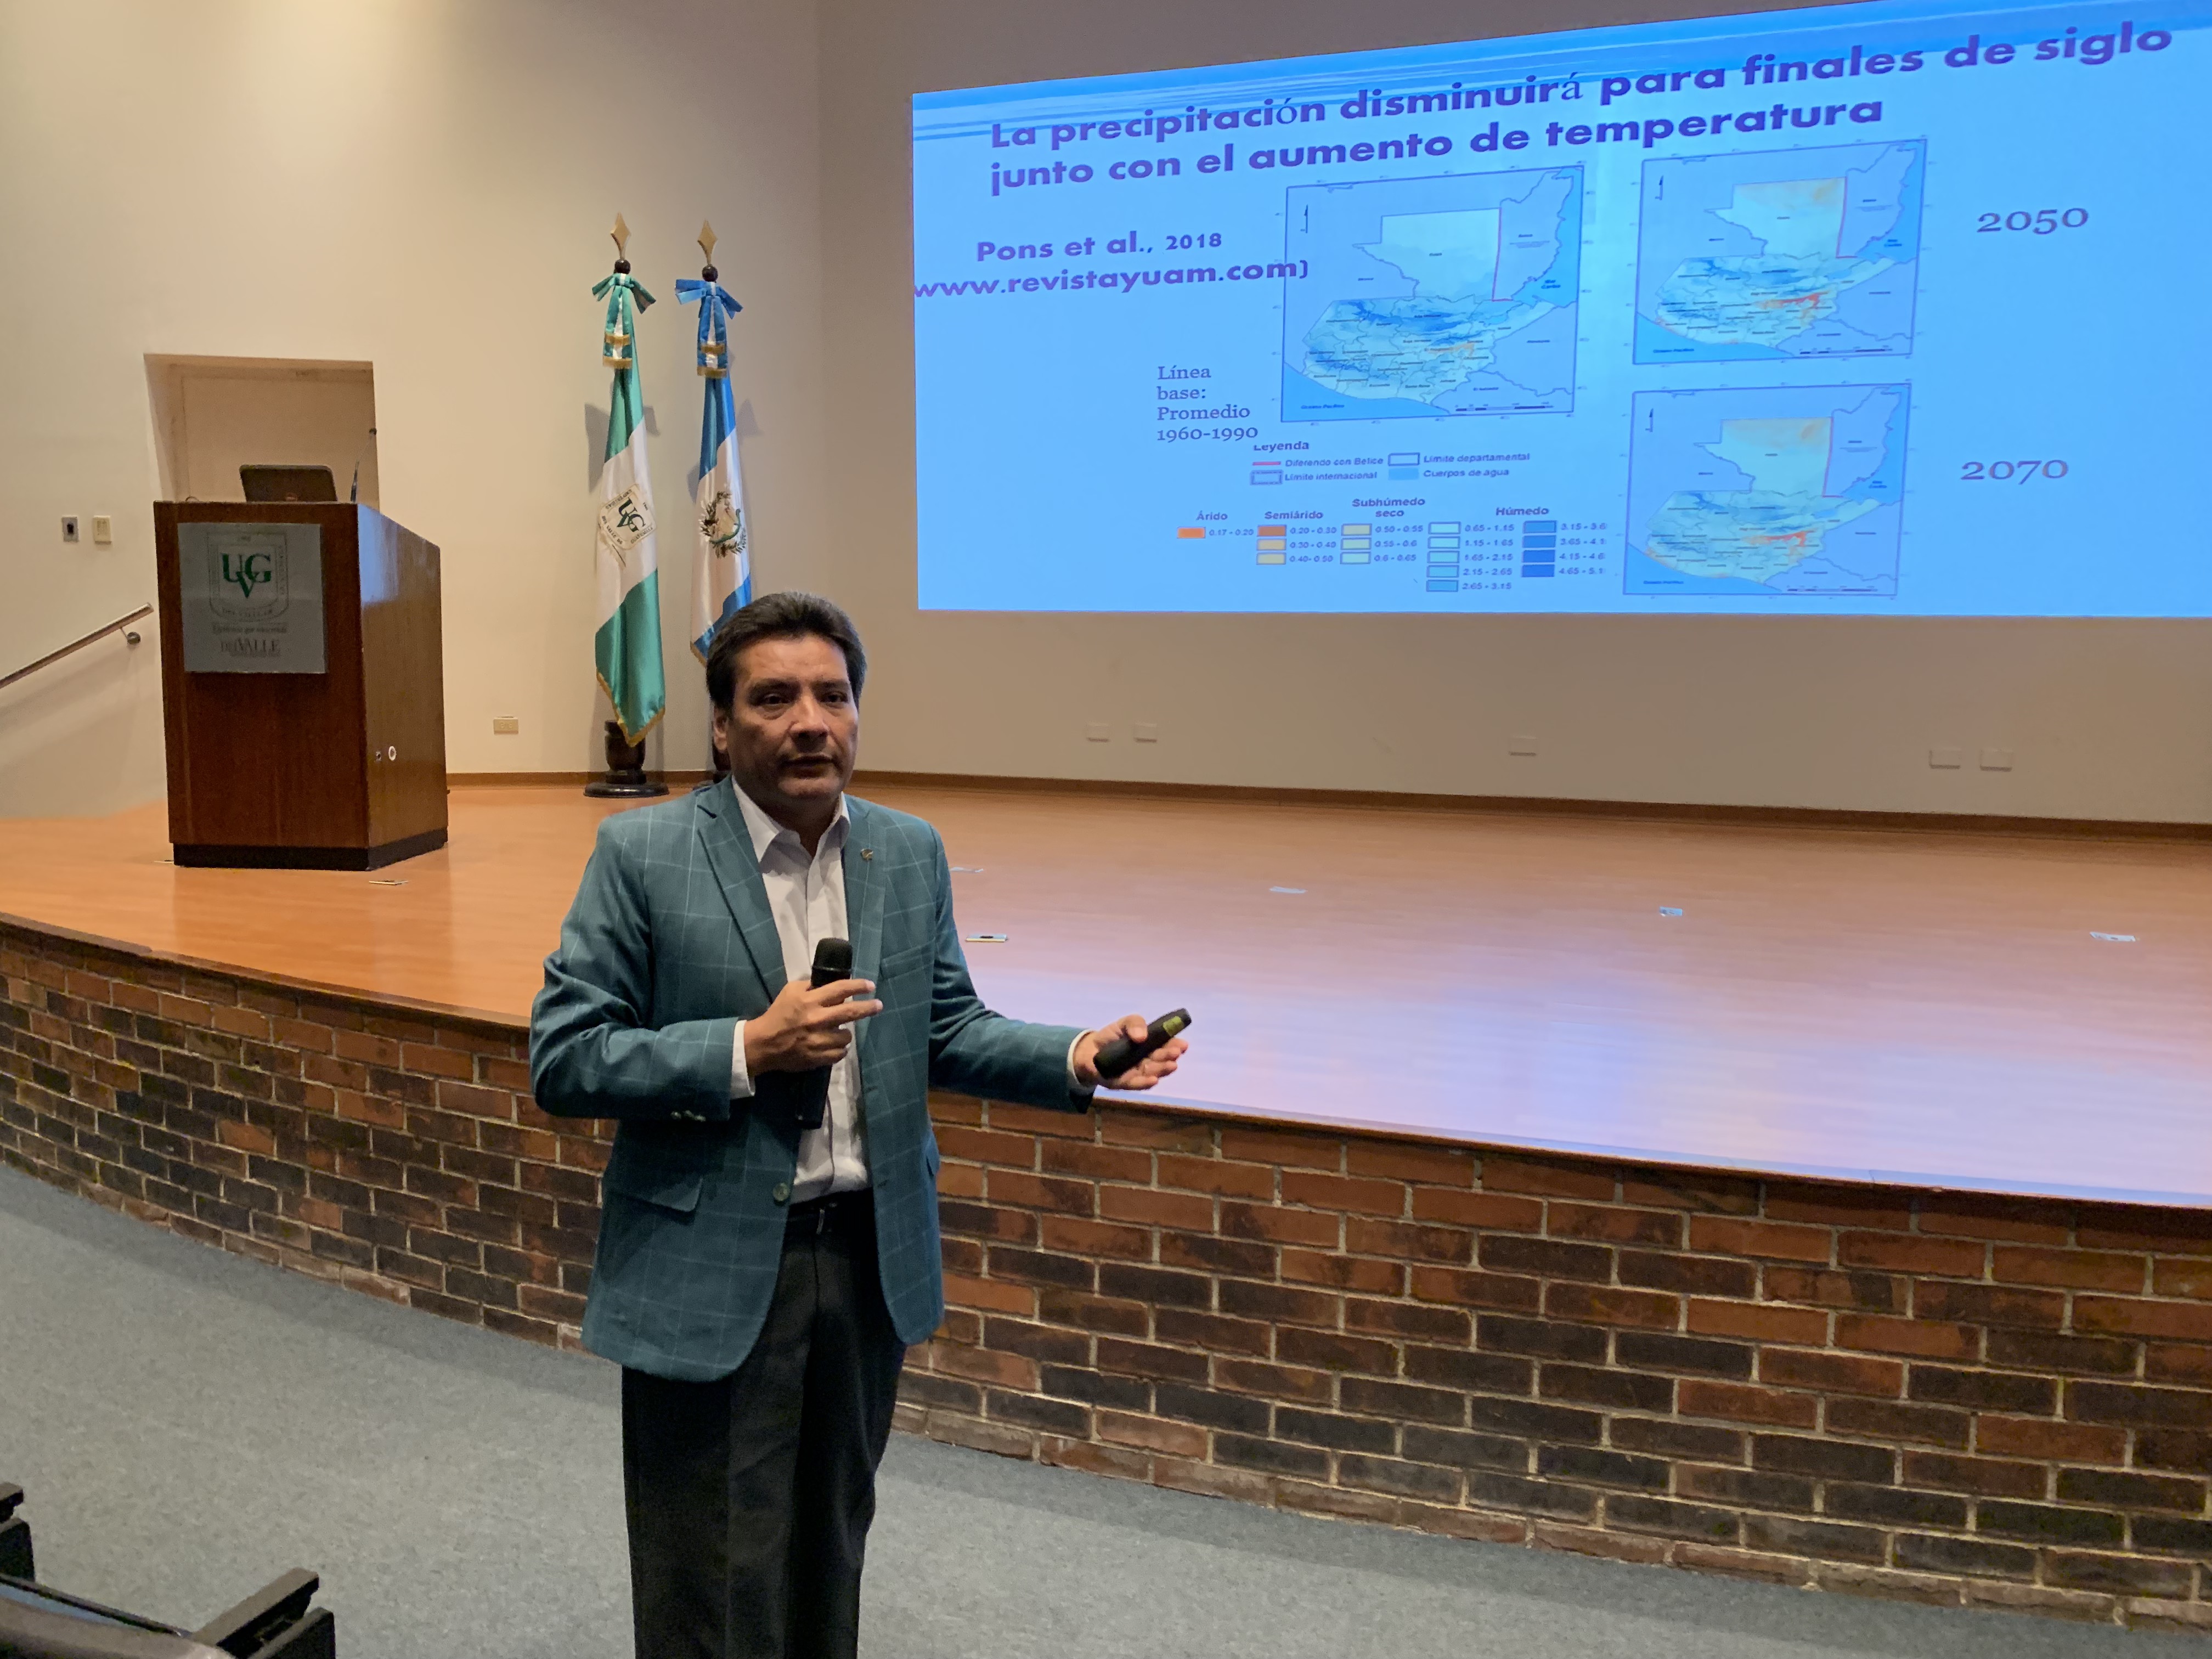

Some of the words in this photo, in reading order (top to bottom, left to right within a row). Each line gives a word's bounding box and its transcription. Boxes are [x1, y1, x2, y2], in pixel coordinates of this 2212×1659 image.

[991, 123, 1036, 148] La
[1051, 98, 1325, 150] precipitación
[1340, 72, 1582, 119] disminuirá
[1600, 69, 1725, 105] para
[1742, 46, 1923, 85] finales
[1945, 35, 2015, 67] de
[2034, 21, 2171, 65] siglo
[991, 161, 1093, 196] junto
[1109, 158, 1180, 180] con
[1197, 144, 1233, 173] el
[1249, 136, 1452, 170] aumento
[1470, 122, 1530, 152] de
[1546, 99, 1882, 148] temperatura
[1977, 208, 2088, 235] 2050
[978, 242, 1053, 261] Pons
[1065, 238, 1095, 256] et
[1107, 230, 1152, 253] al.,
[1166, 233, 1221, 250] 2018
[913, 260, 1308, 297] www.revistayuam.com)
[1158, 365, 1211, 380] Línea
[1156, 385, 1206, 400] base:
[1158, 404, 1250, 420] Promedio
[1158, 427, 1258, 443] 1960-1990
[1285, 458, 1331, 467] Diferendo
[1353, 456, 1384, 466] Belice
[1423, 455, 1455, 463] Límite
[1457, 452, 1531, 463] departamental
[1284, 473, 1314, 481] Límite
[1316, 471, 1378, 481] internacional
[1423, 469, 1466, 478] Cuerpos
[1468, 469, 1482, 477] de
[1482, 469, 1510, 478] agua
[1961, 460, 2068, 484] 2070
[1352, 496, 1426, 507] Subhúmedo
[1195, 510, 1228, 521] Árido
[1264, 510, 1324, 520] Semiárido
[1375, 509, 1404, 518] seco
[1496, 506, 1549, 516] Húmedo
